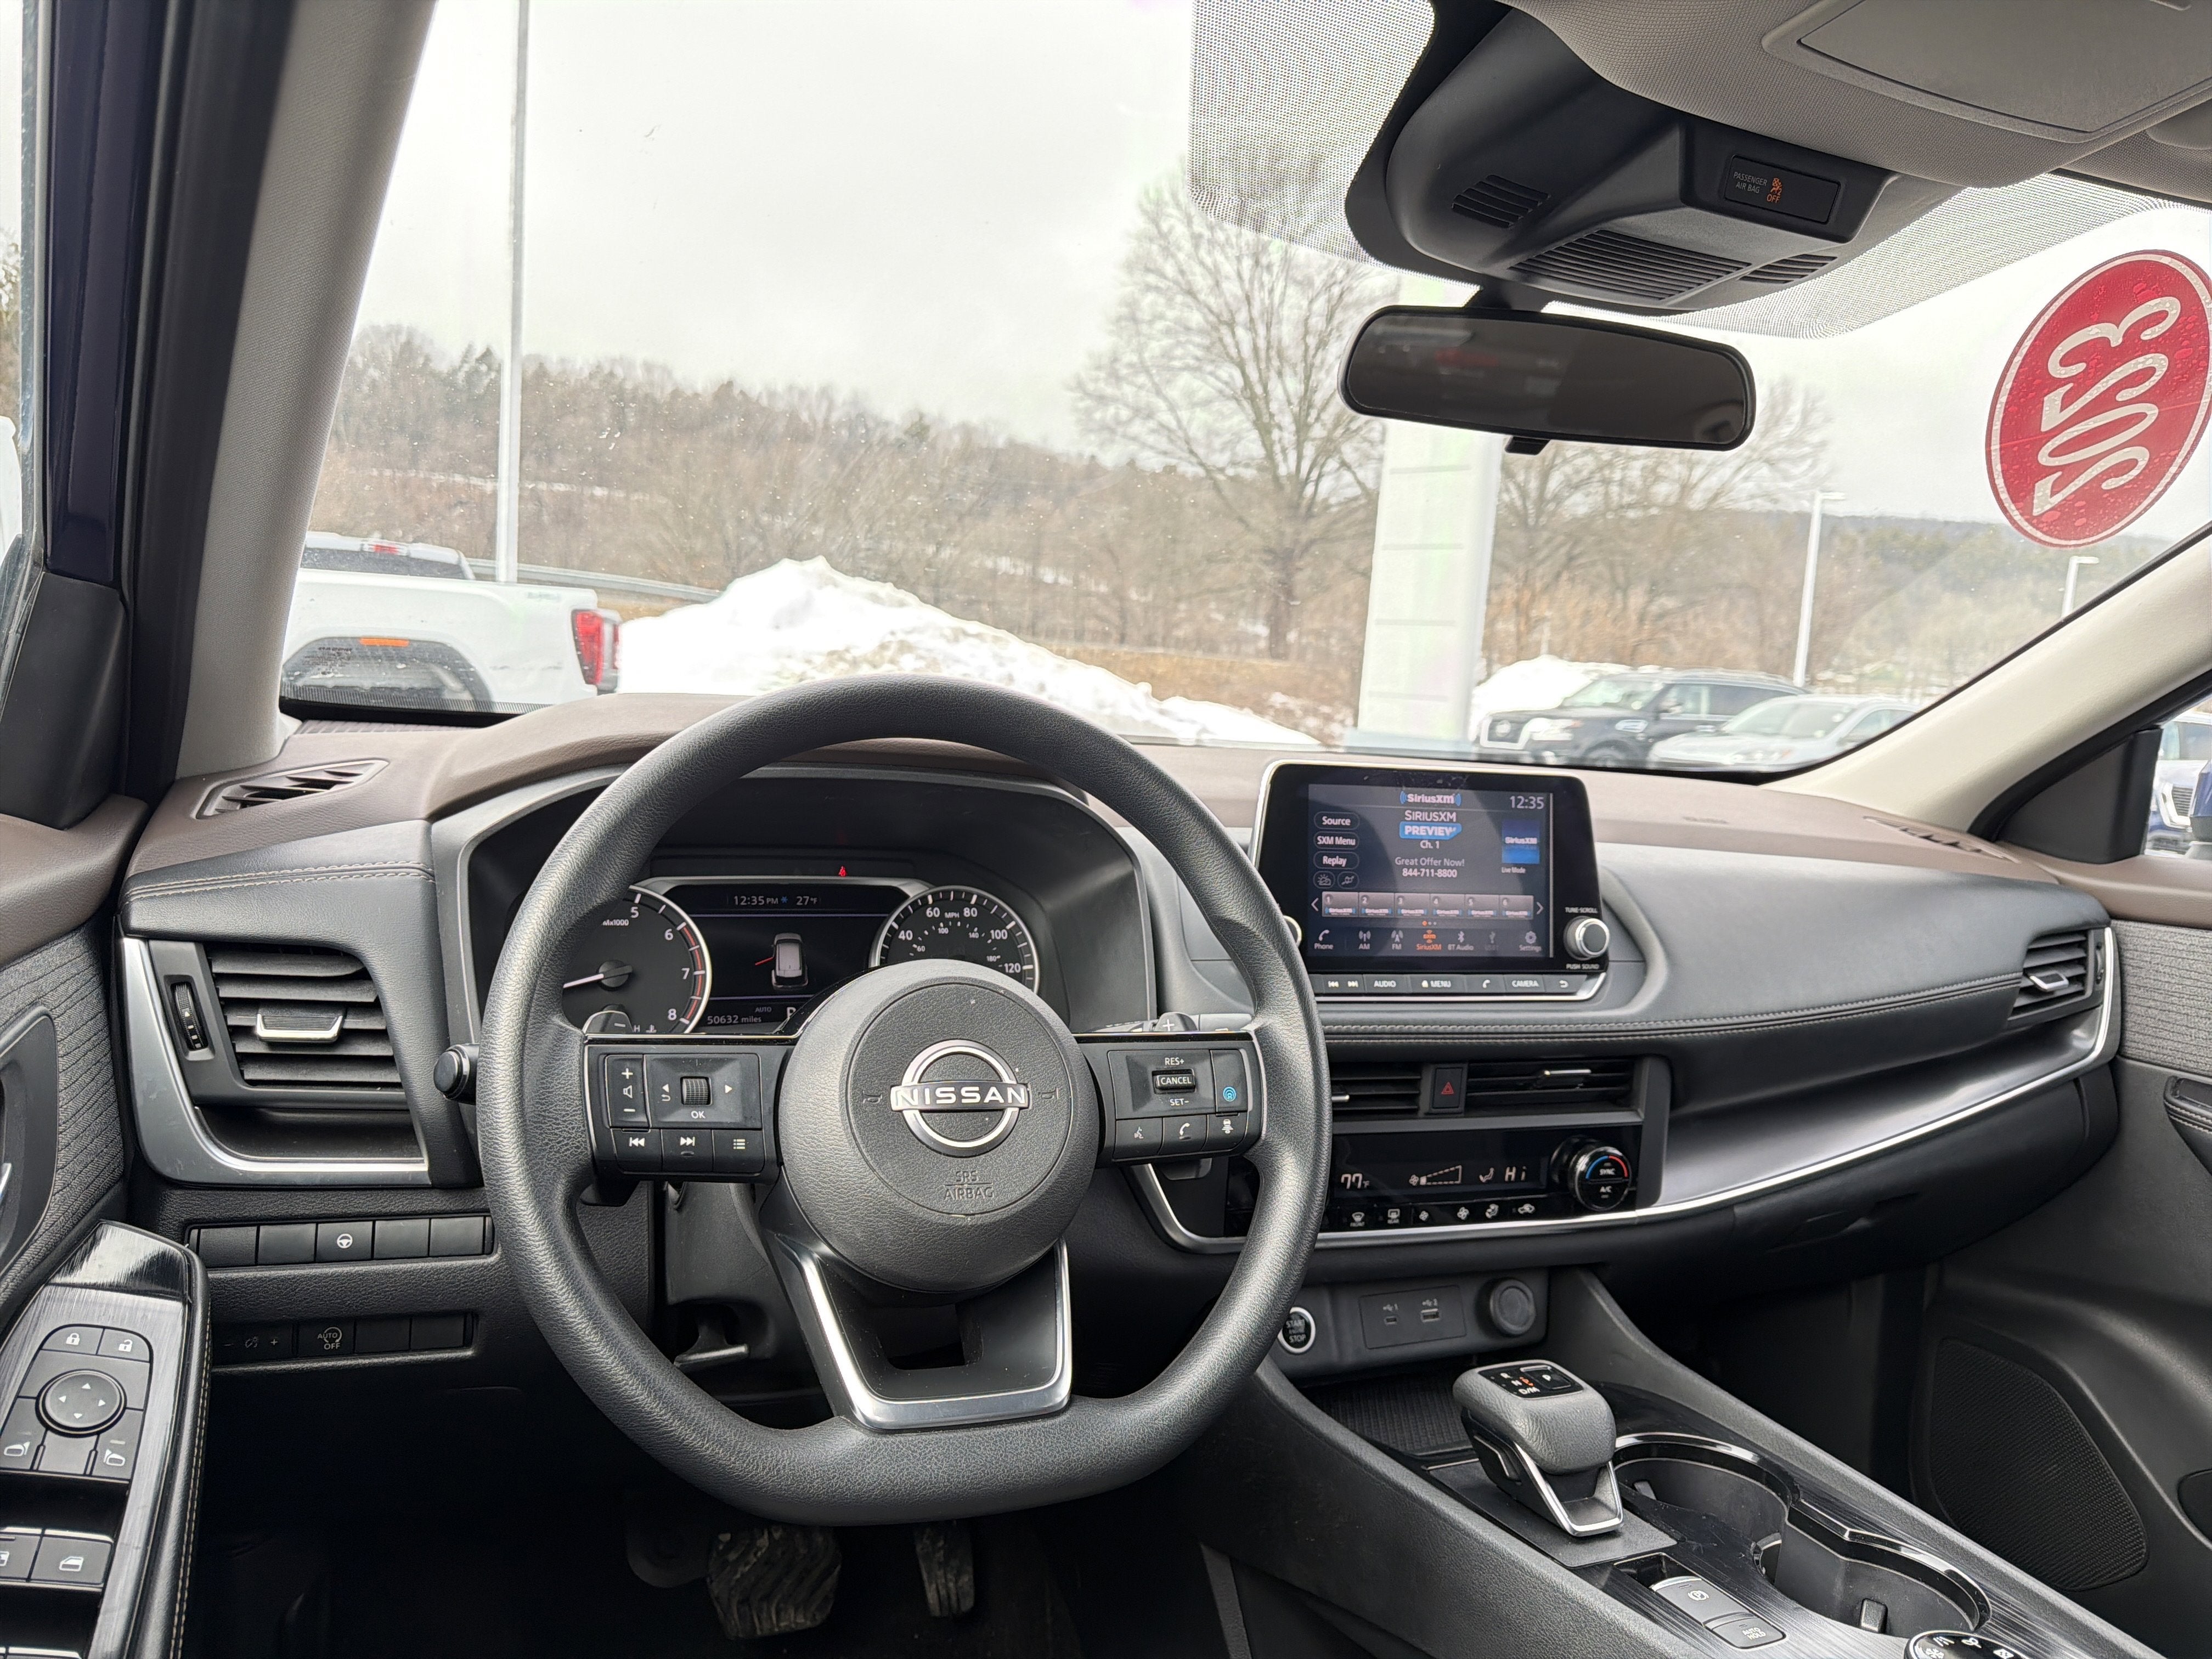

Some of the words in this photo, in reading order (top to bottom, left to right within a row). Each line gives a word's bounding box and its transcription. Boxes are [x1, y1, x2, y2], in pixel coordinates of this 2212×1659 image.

[1733, 171, 1768, 187] PASSENGER
[1735, 182, 1747, 191] AIR
[1747, 184, 1760, 194] BAG
[1767, 194, 1781, 204] OFF
[1510, 795, 1545, 810] 12:35
[1322, 816, 1351, 826] Source
[1404, 810, 1457, 822] SIRIUSXM
[1404, 825, 1457, 836] PREVIEW
[1317, 836, 1334, 845] SXM
[1335, 837, 1356, 846] Menu
[1420, 840, 1434, 849] Ch.
[1435, 840, 1440, 849] 1
[1322, 855, 1347, 867] Replay
[1395, 857, 1418, 866] Great
[1419, 857, 1442, 866] Offer
[1443, 858, 1465, 867] Now!
[1402, 867, 1458, 878] 844-711-8800
[734, 895, 764, 905] 12:35
[630, 906, 639, 918] 5
[926, 907, 940, 917] 60
[963, 907, 978, 917] 80
[664, 928, 674, 940] 6
[898, 930, 913, 940] 40
[990, 929, 1008, 940] 100
[1519, 944, 1542, 952] Settings
[1005, 963, 1021, 973] 120
[681, 968, 690, 980] 7
[668, 1008, 676, 1020] 8
[707, 1015, 739, 1024] 50632
[1161, 1076, 1192, 1085] CANCEL
[896, 1086, 1025, 1107] NISSAN
[691, 1110, 706, 1119] OK
[956, 1170, 979, 1182] SRS
[944, 1186, 995, 1200] AIRBAG
[1289, 1334, 1306, 1343] STOP
[1518, 1386, 1541, 1395] D/M
[1742, 1627, 1761, 1636] AUTO
[1747, 1631, 1766, 1640] HOLD
